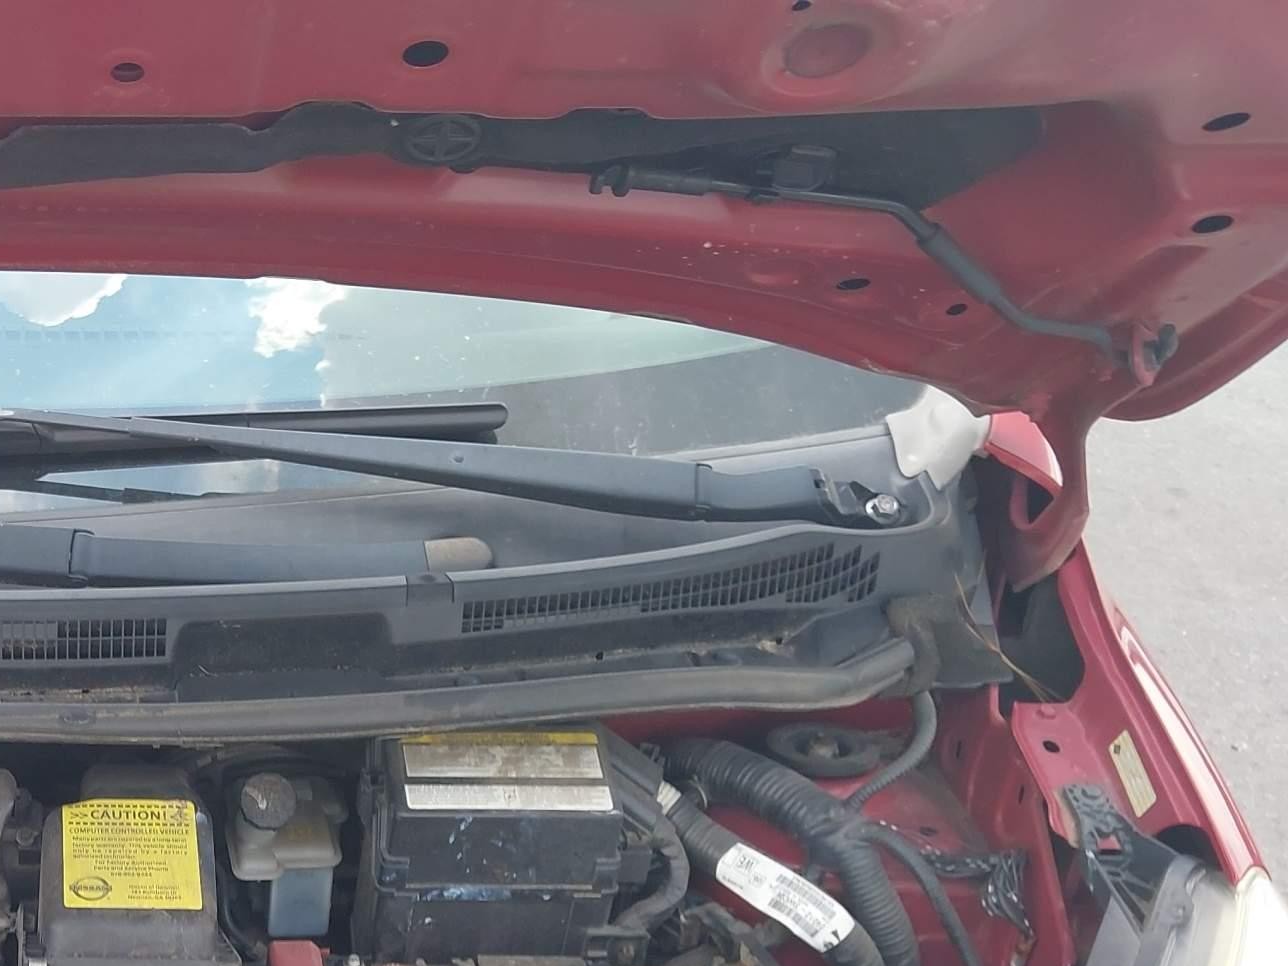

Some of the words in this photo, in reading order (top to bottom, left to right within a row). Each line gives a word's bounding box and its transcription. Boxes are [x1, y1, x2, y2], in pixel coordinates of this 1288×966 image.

[90, 809, 167, 820] CAUTION!
[69, 827, 109, 835] COMPUTER
[110, 827, 158, 836] CONTROLLED
[159, 828, 189, 837] VEHICLE
